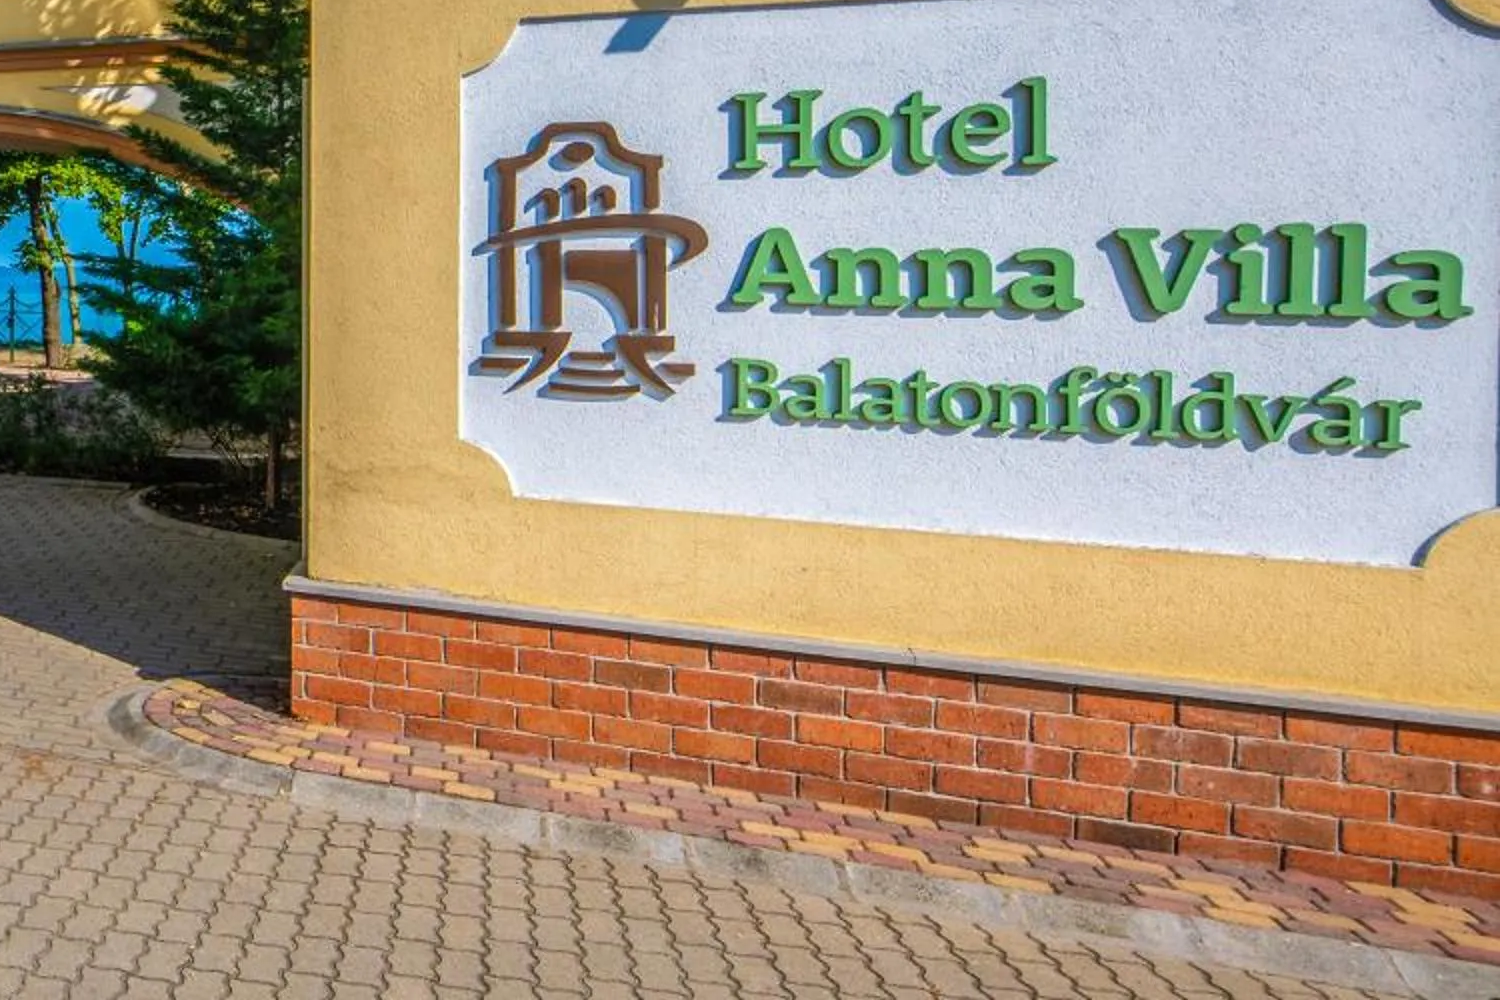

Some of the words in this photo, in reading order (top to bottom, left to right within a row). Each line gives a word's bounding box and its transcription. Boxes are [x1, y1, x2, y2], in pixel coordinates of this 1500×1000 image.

[729, 76, 1057, 170] Hotel
[731, 227, 1084, 312] Anna
[1116, 222, 1474, 319] Villa
[730, 357, 1421, 449] Balatonföldvár
